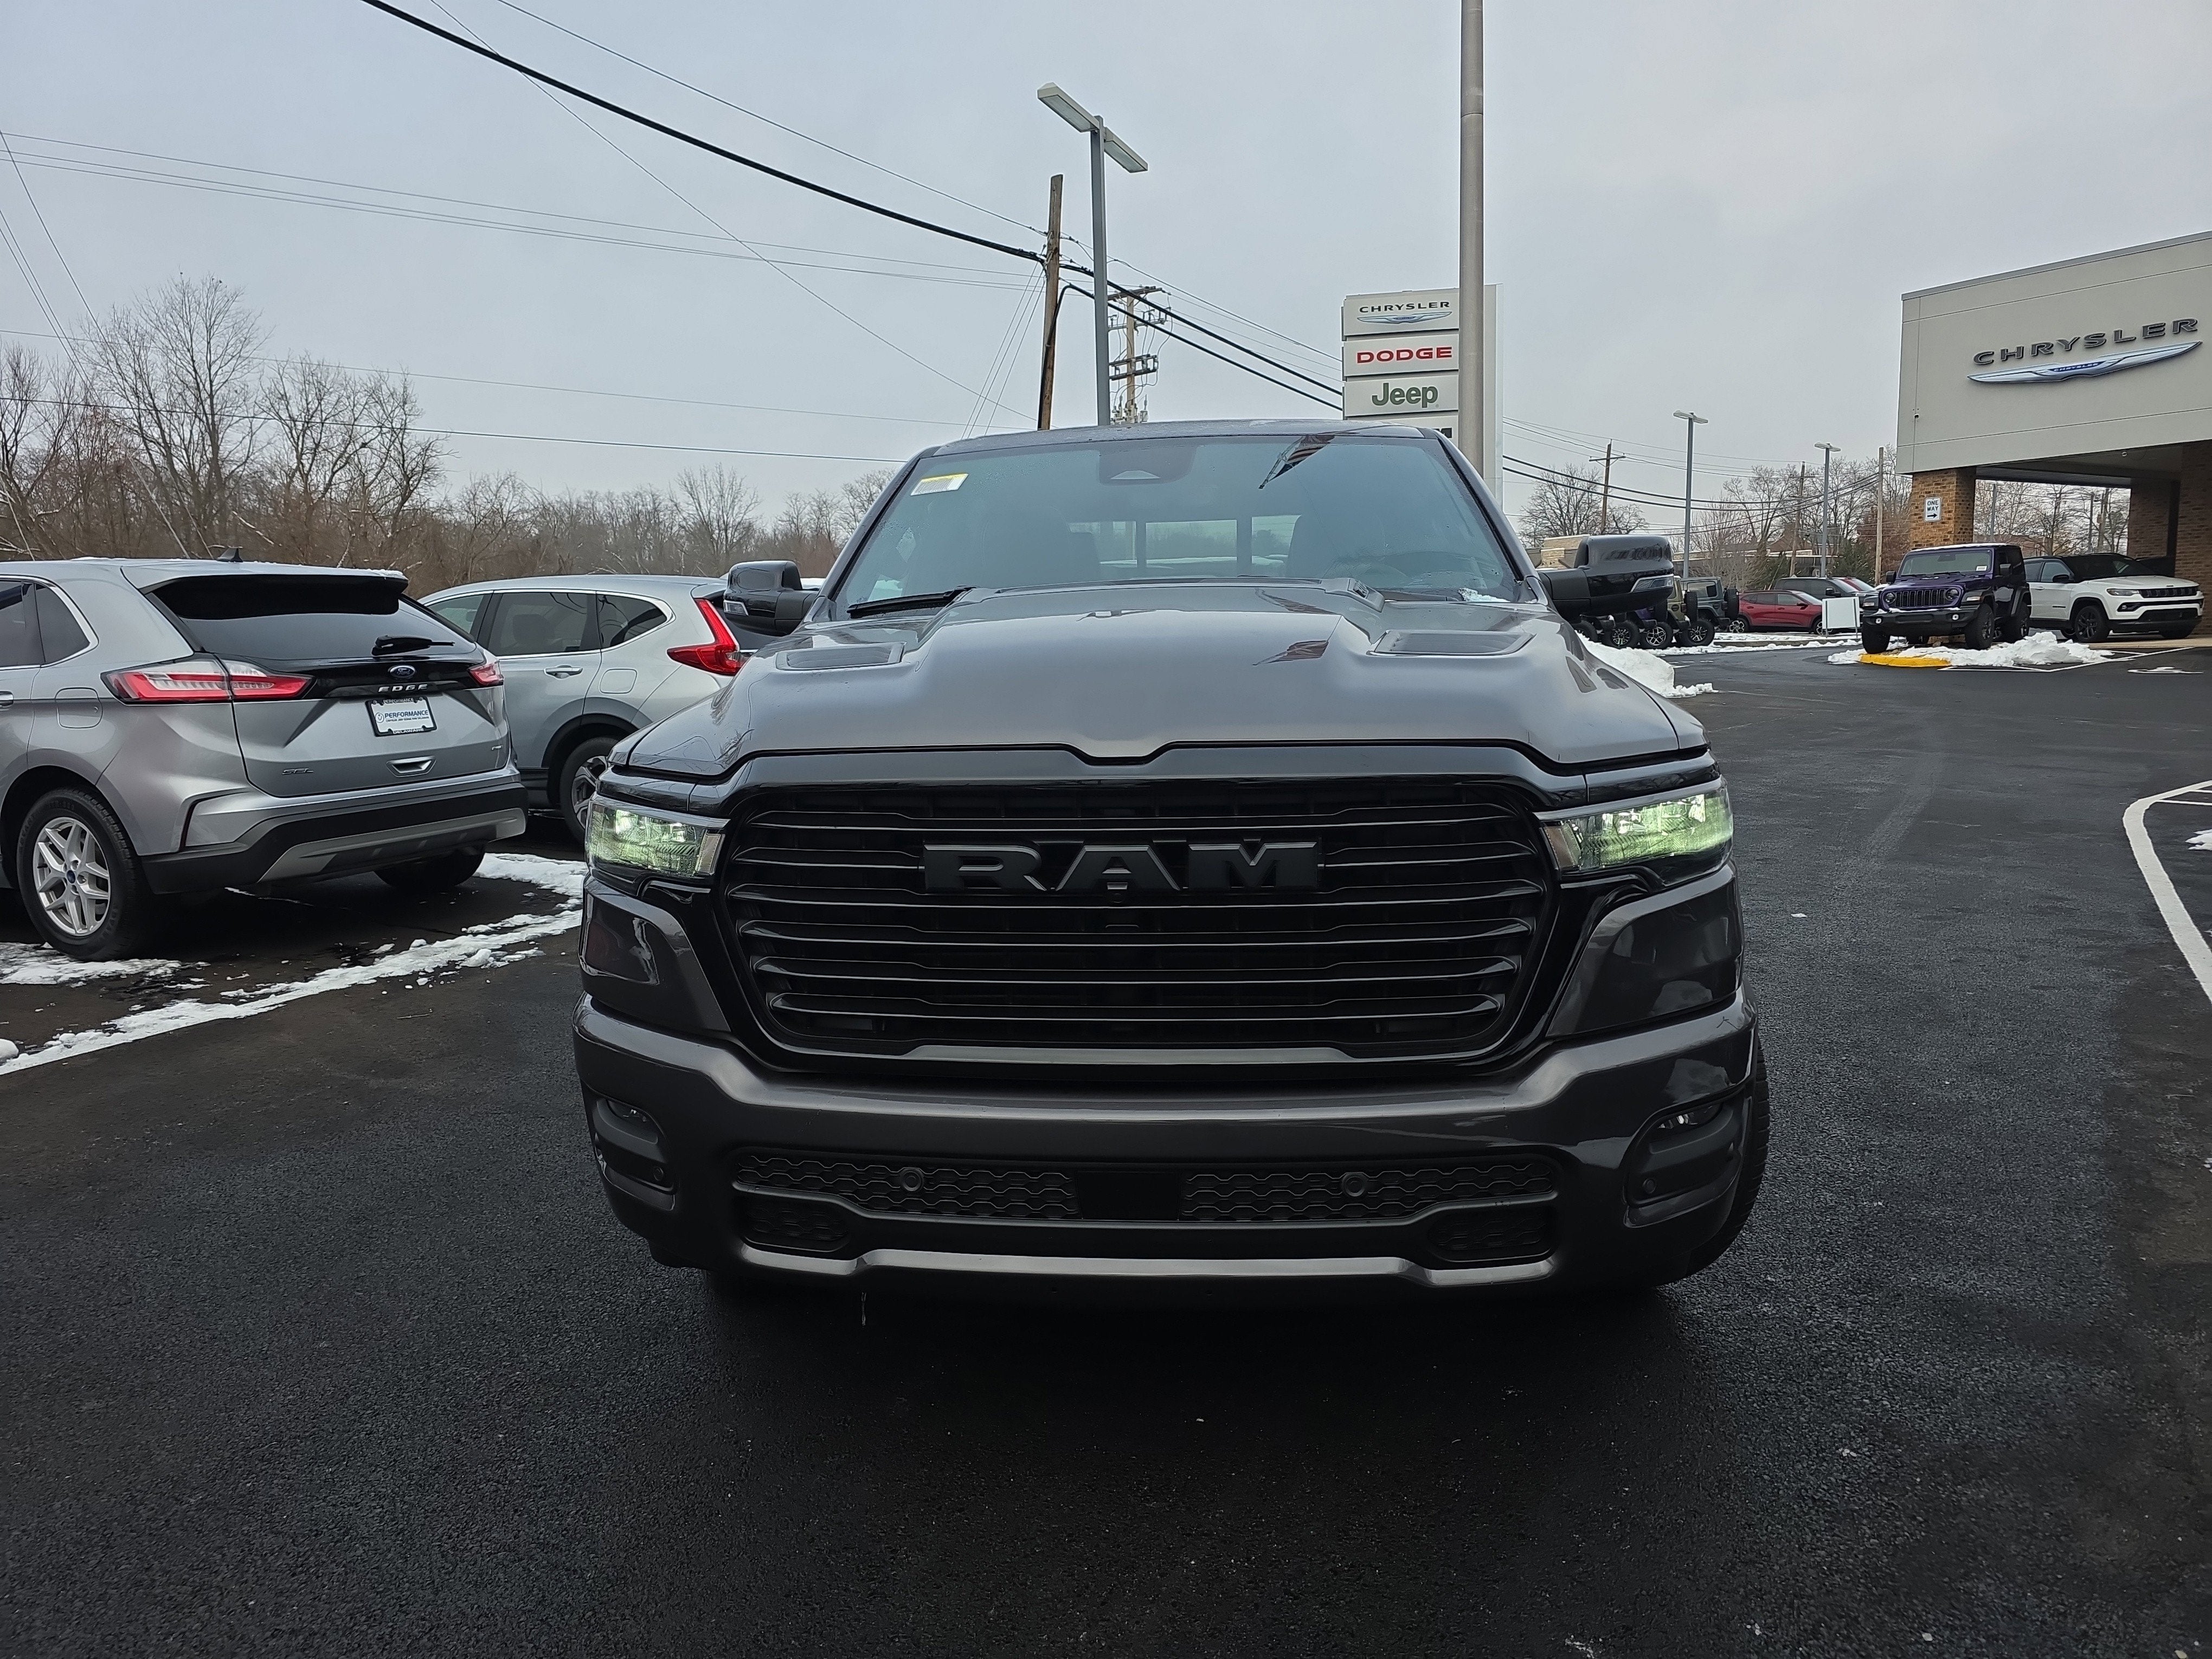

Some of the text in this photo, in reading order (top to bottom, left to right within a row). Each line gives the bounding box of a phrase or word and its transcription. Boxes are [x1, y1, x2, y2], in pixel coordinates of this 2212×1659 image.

[1359, 301, 1450, 313] CHRYSLER
[1972, 318, 2198, 365] CHRYSLER
[1357, 346, 1452, 364] DODGE
[1372, 382, 1438, 408] Jeep
[378, 684, 428, 692] EDGE
[384, 710, 428, 719] PERFORMANCE
[924, 841, 1318, 892] RAM
